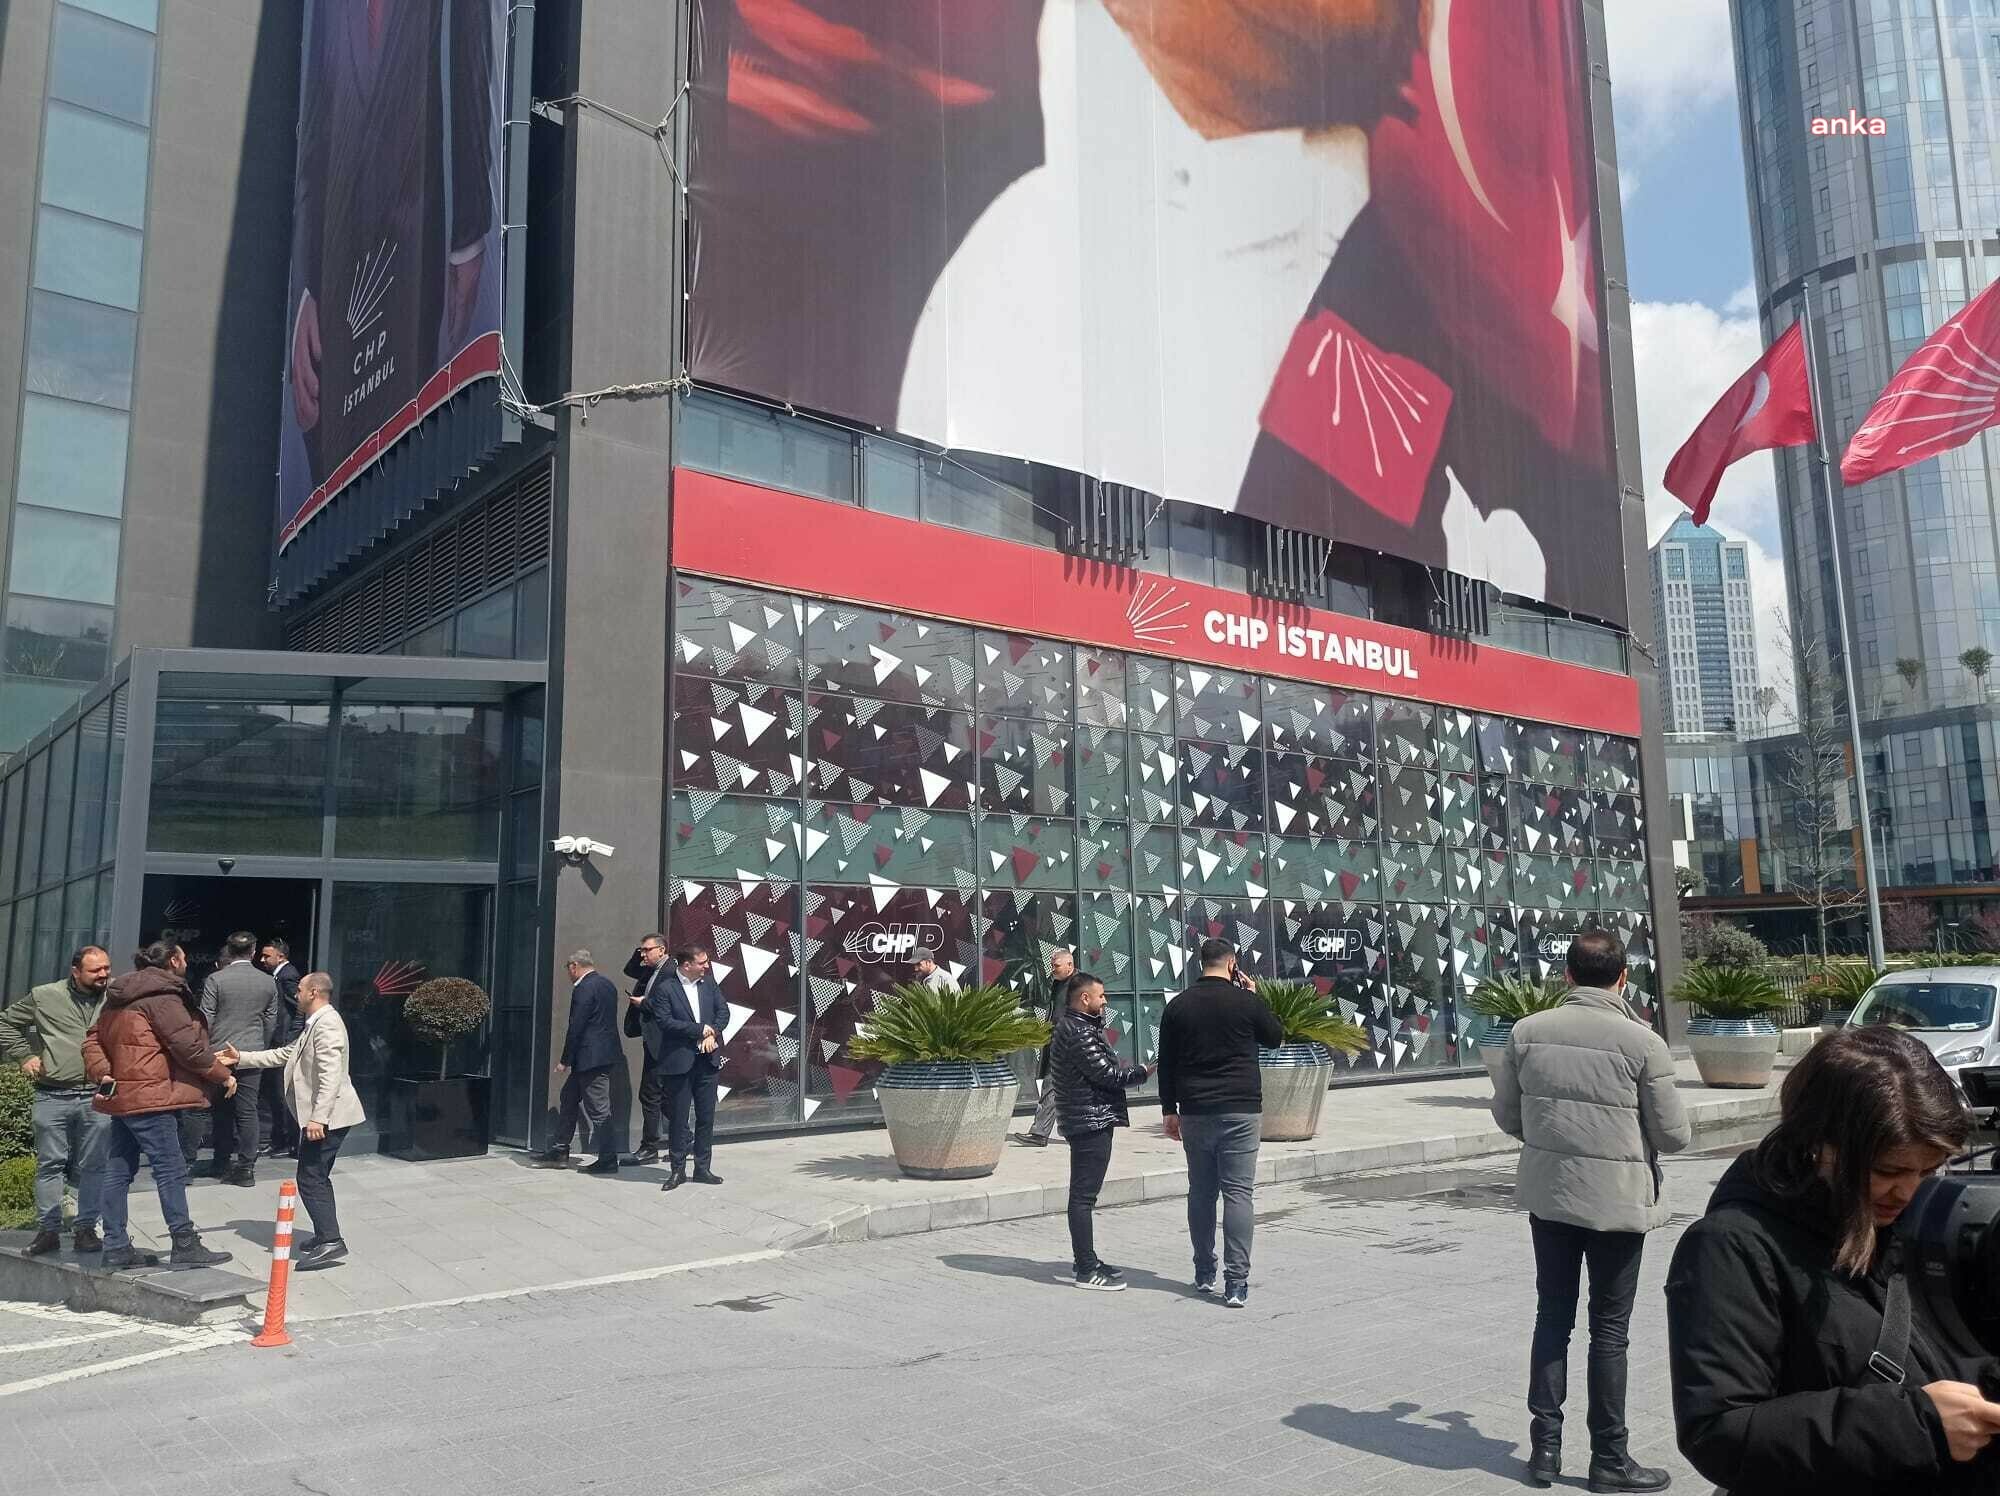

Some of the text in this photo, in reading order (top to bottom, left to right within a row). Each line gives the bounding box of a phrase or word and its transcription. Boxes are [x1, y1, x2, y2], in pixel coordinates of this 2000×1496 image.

[353, 331, 387, 375] CHP
[343, 356, 395, 417] İSTANBUL
[1203, 609, 1419, 680] CHP İSTANBUL
[872, 932, 916, 954] CHP
[1318, 936, 1345, 953] CHP
